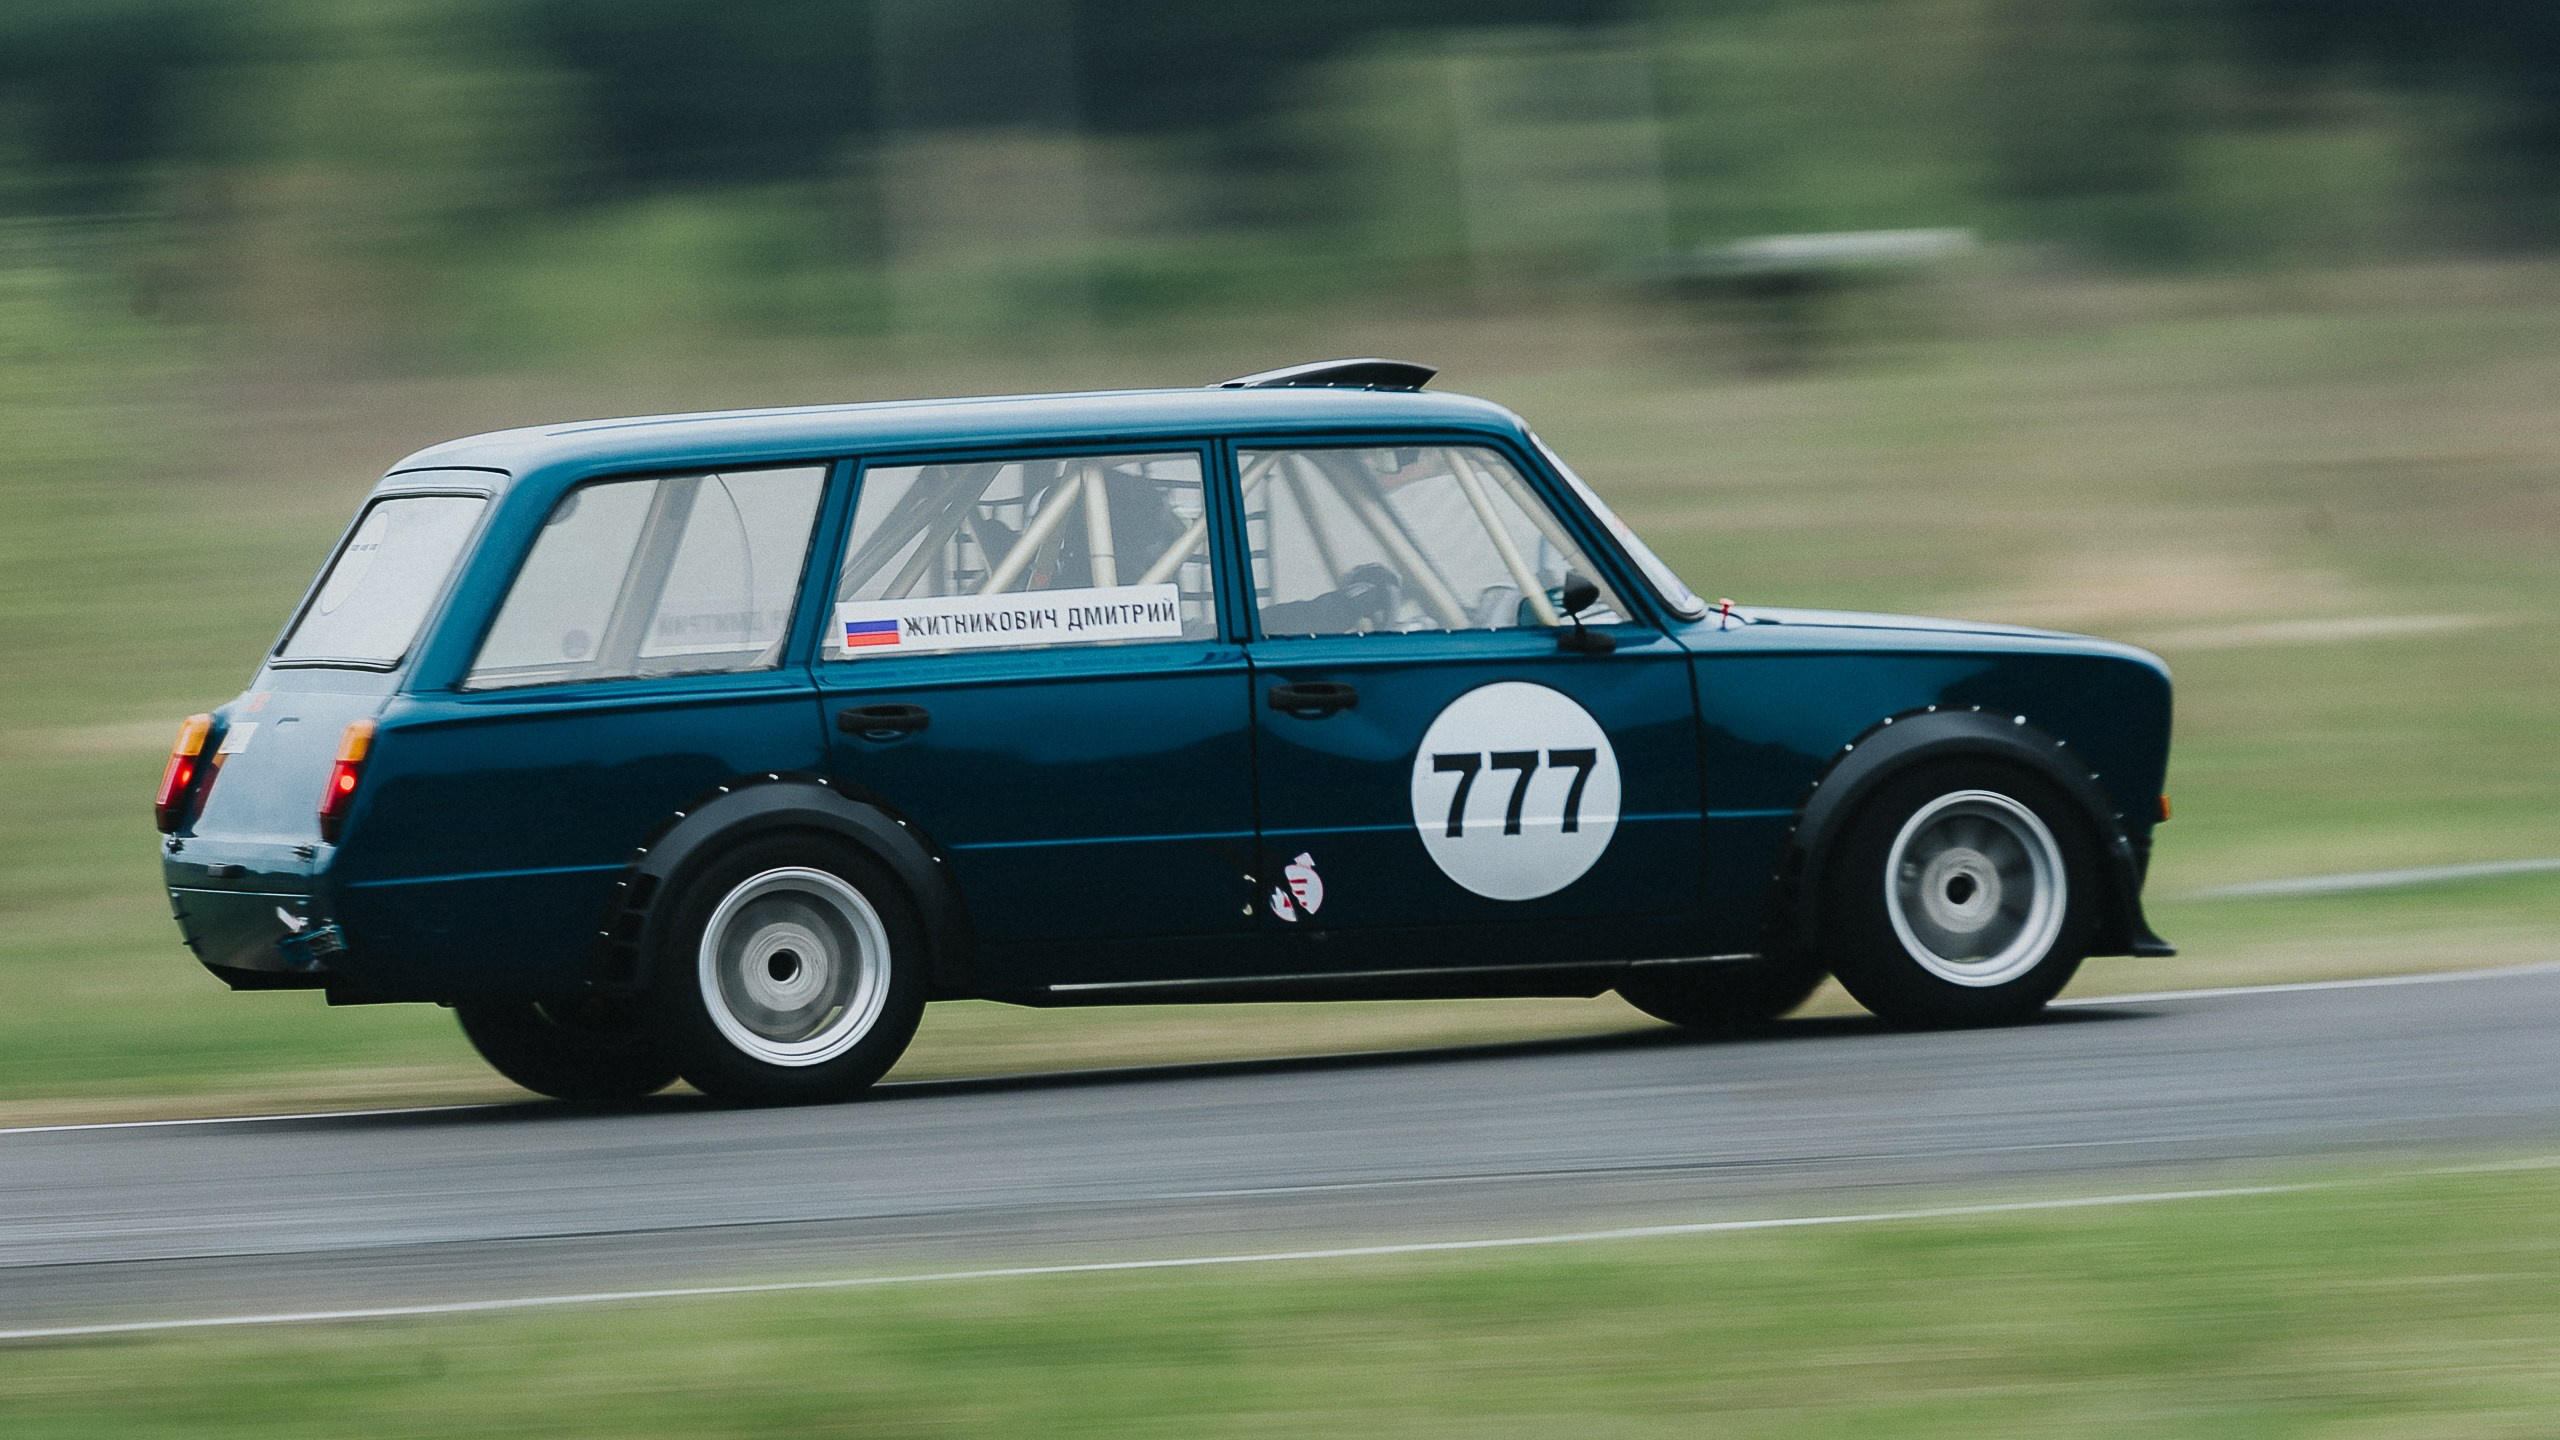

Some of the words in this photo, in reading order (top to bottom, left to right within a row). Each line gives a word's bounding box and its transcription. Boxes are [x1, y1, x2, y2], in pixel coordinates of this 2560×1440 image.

[904, 609, 1058, 637] ЖИТНИКОВИЧ
[1067, 599, 1176, 631] ДМИТРИЙ
[1433, 748, 1596, 838] 777
